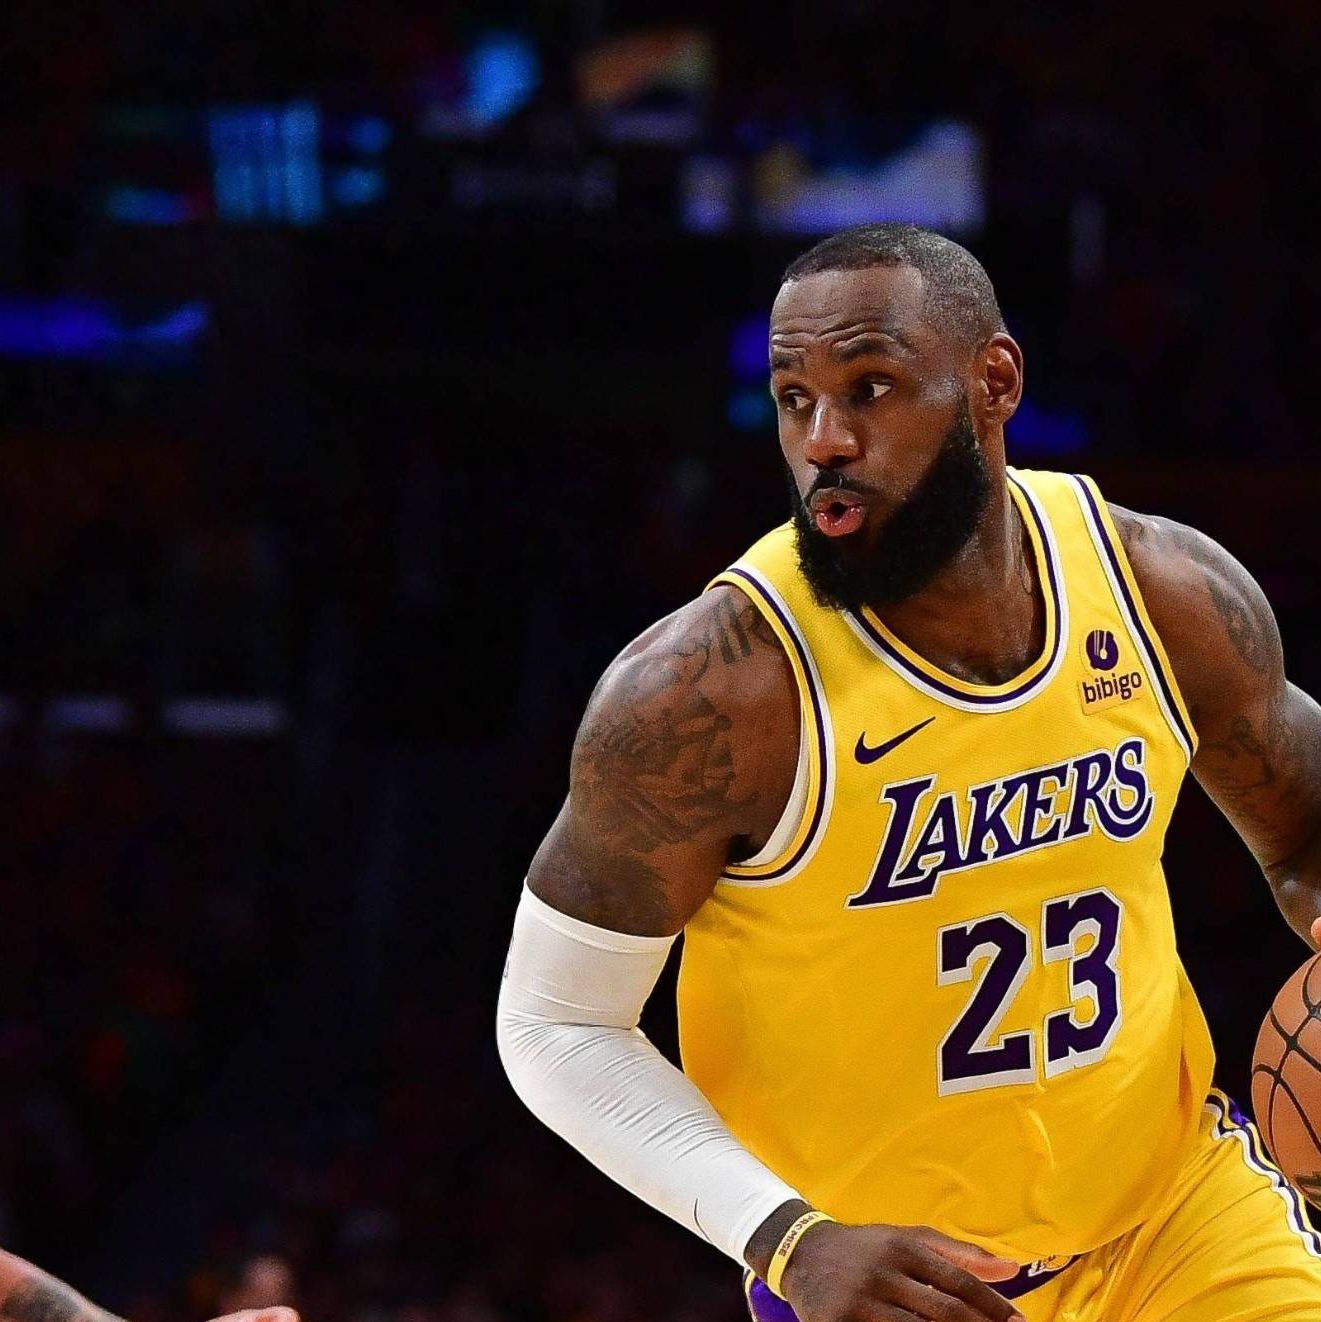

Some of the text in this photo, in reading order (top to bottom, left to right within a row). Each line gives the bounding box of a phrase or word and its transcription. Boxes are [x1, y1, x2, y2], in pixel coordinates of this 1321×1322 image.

[1081, 671, 1142, 704] bibigo
[843, 737, 1154, 910] LAKERS
[937, 887, 1125, 1097] 23
